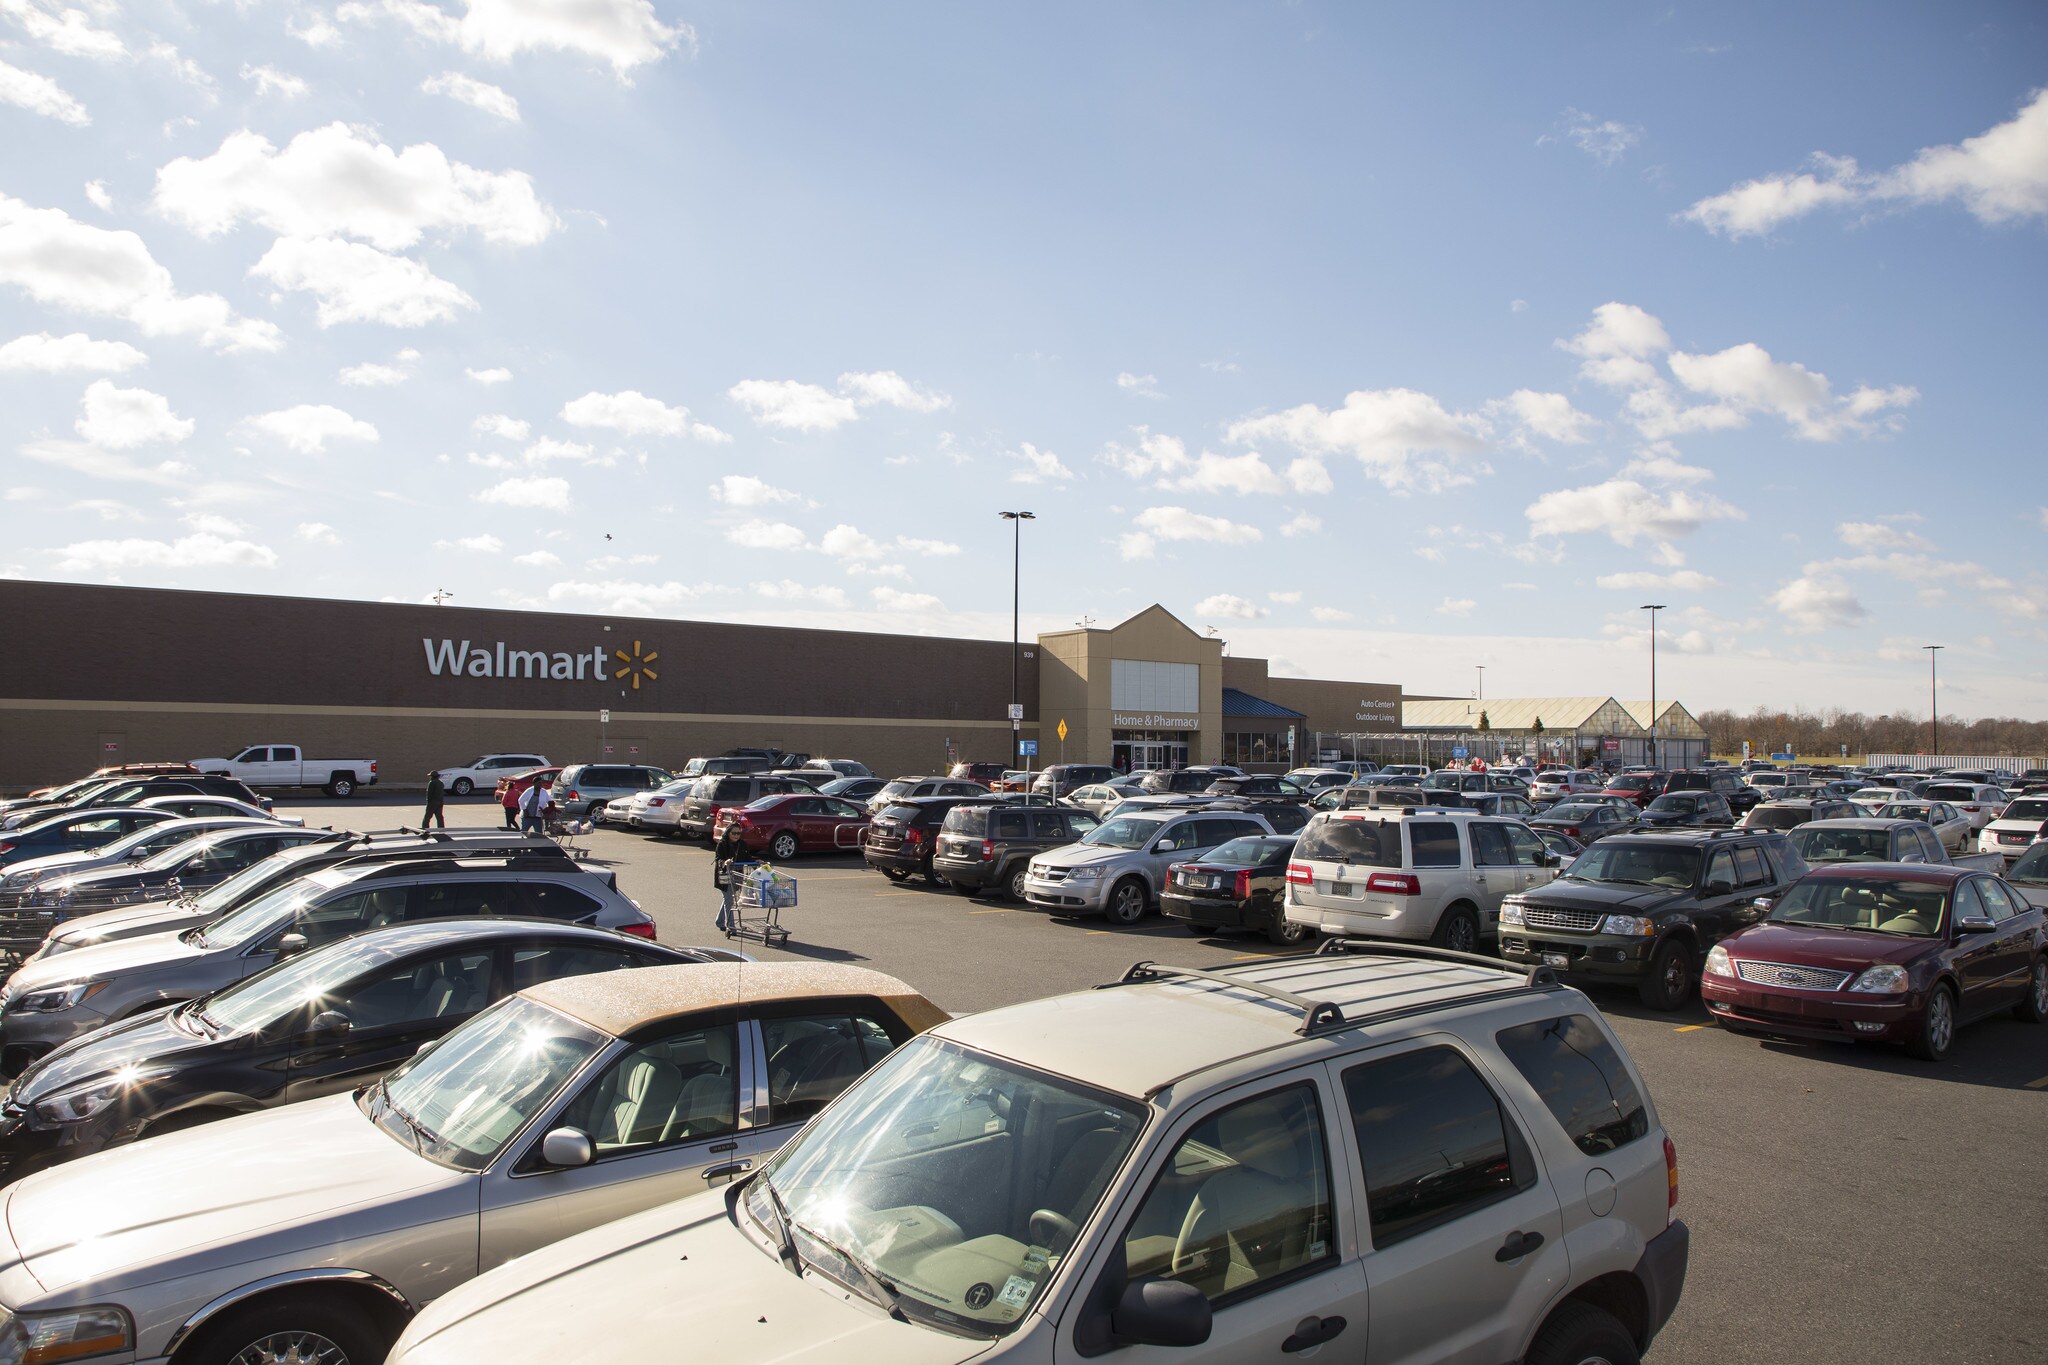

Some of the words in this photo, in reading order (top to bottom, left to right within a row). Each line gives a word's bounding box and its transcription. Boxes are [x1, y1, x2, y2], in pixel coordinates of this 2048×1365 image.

[423, 638, 608, 681] Walmart
[1361, 700, 1374, 708] Auto
[1374, 700, 1392, 708] Center
[1114, 713, 1143, 726] Home
[1144, 714, 1152, 727] &
[1153, 714, 1199, 730] Pharmacy
[1356, 712, 1378, 720] Outdoor
[1380, 714, 1394, 723] Living
[1006, 1286, 1014, 1296] 9
[1016, 1290, 1026, 1298] 08
